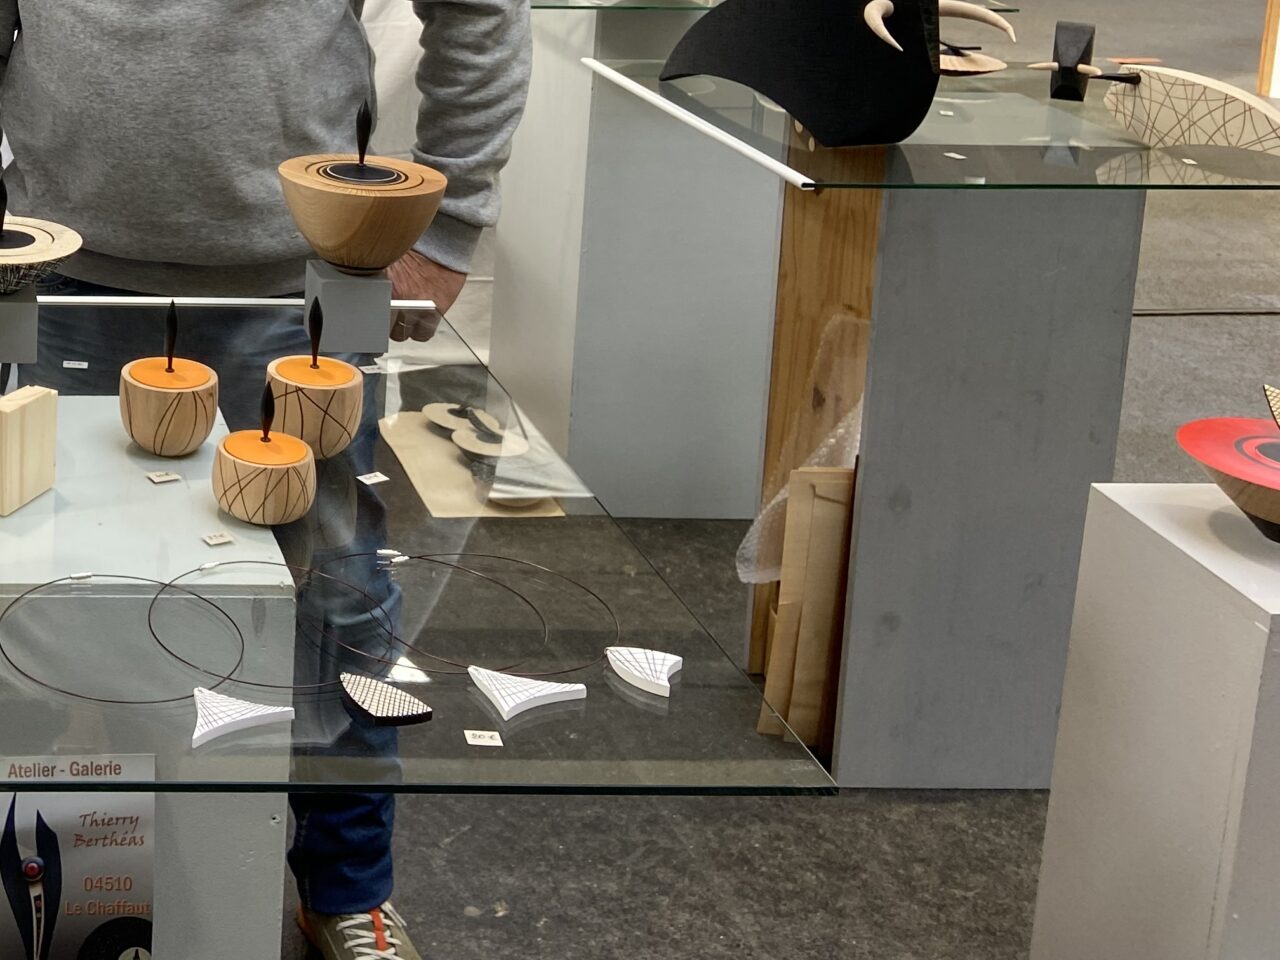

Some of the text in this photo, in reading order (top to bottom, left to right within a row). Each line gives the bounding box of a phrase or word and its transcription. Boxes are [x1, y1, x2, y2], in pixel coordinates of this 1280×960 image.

[8, 763, 57, 778] Atelier
[69, 761, 122, 777] Galerie
[79, 811, 140, 833] Thierry
[73, 831, 145, 849] Berthéas
[84, 876, 133, 892] 04510
[64, 899, 151, 916] Le Chaffaut
